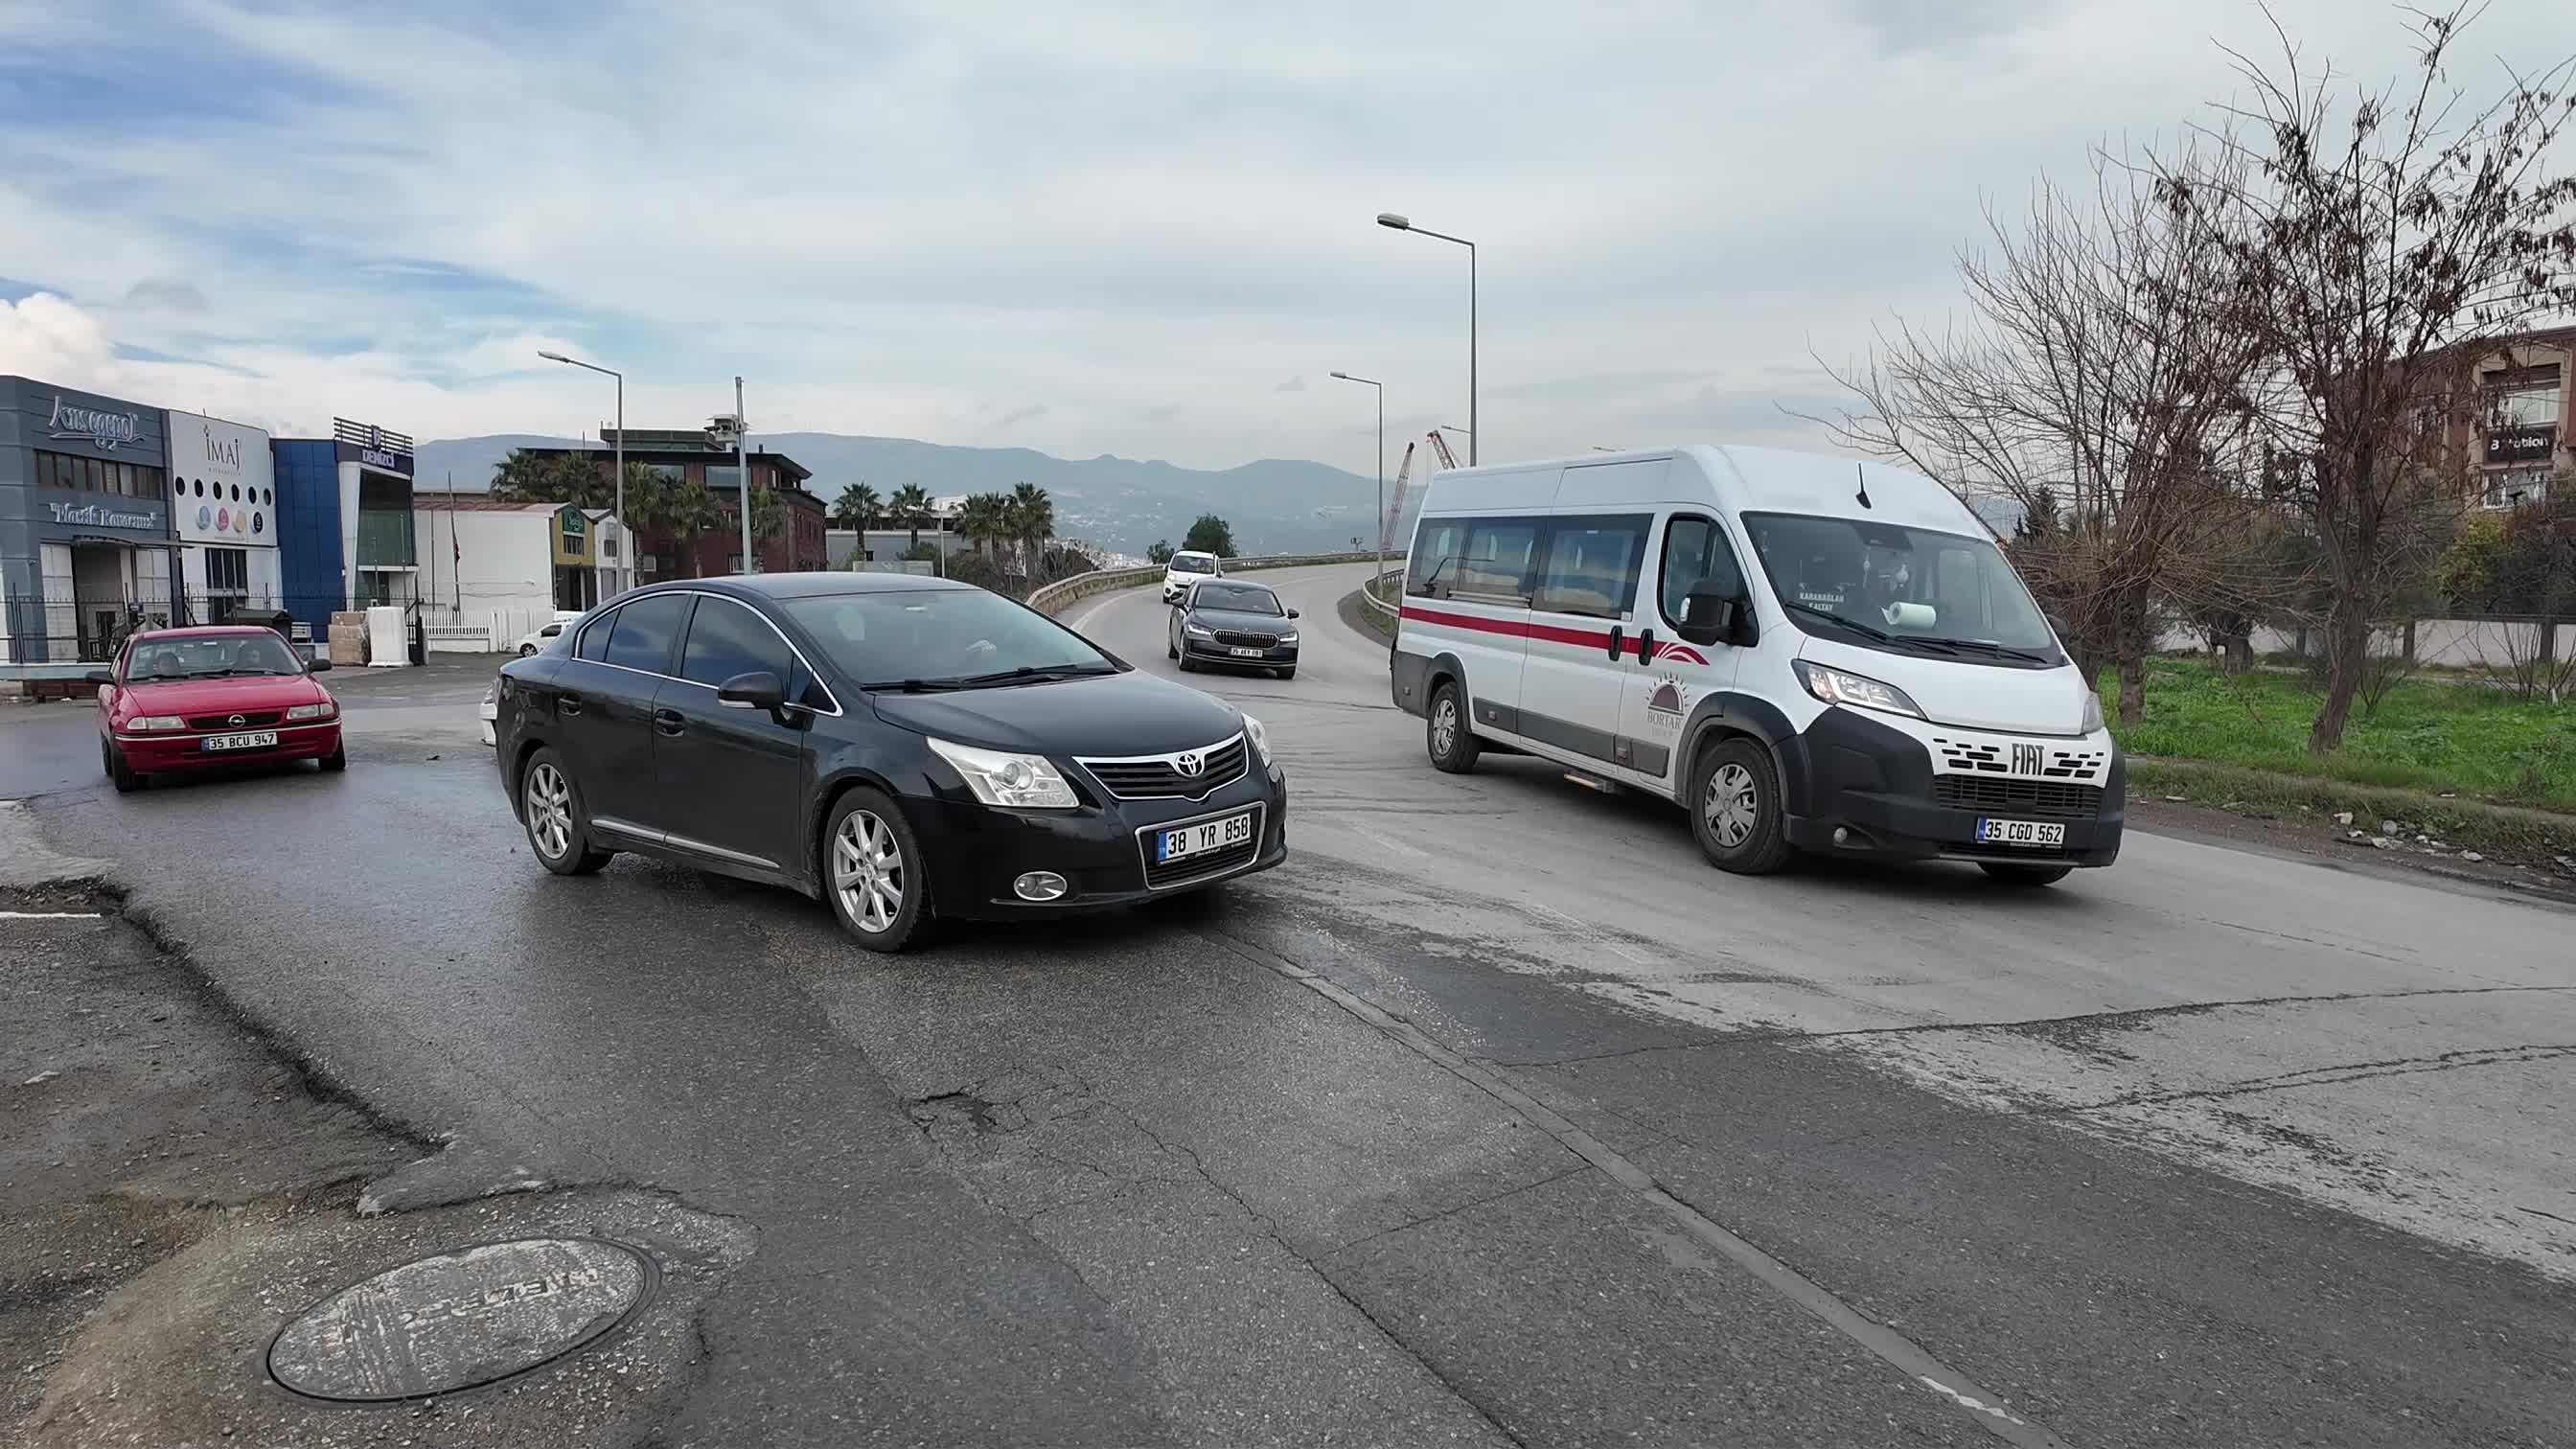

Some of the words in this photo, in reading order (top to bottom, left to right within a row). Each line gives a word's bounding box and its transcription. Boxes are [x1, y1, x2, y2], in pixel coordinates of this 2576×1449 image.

[210, 738, 224, 748] 35
[229, 735, 250, 748] BCU
[254, 733, 274, 745] 947
[2011, 743, 2045, 776] FIAT
[1168, 831, 1187, 855] 38
[1199, 824, 1217, 848] YR
[1225, 816, 1249, 841] 858
[1985, 821, 2003, 839] 35
[2008, 822, 2033, 840] CGD
[2037, 825, 2062, 842] 562
